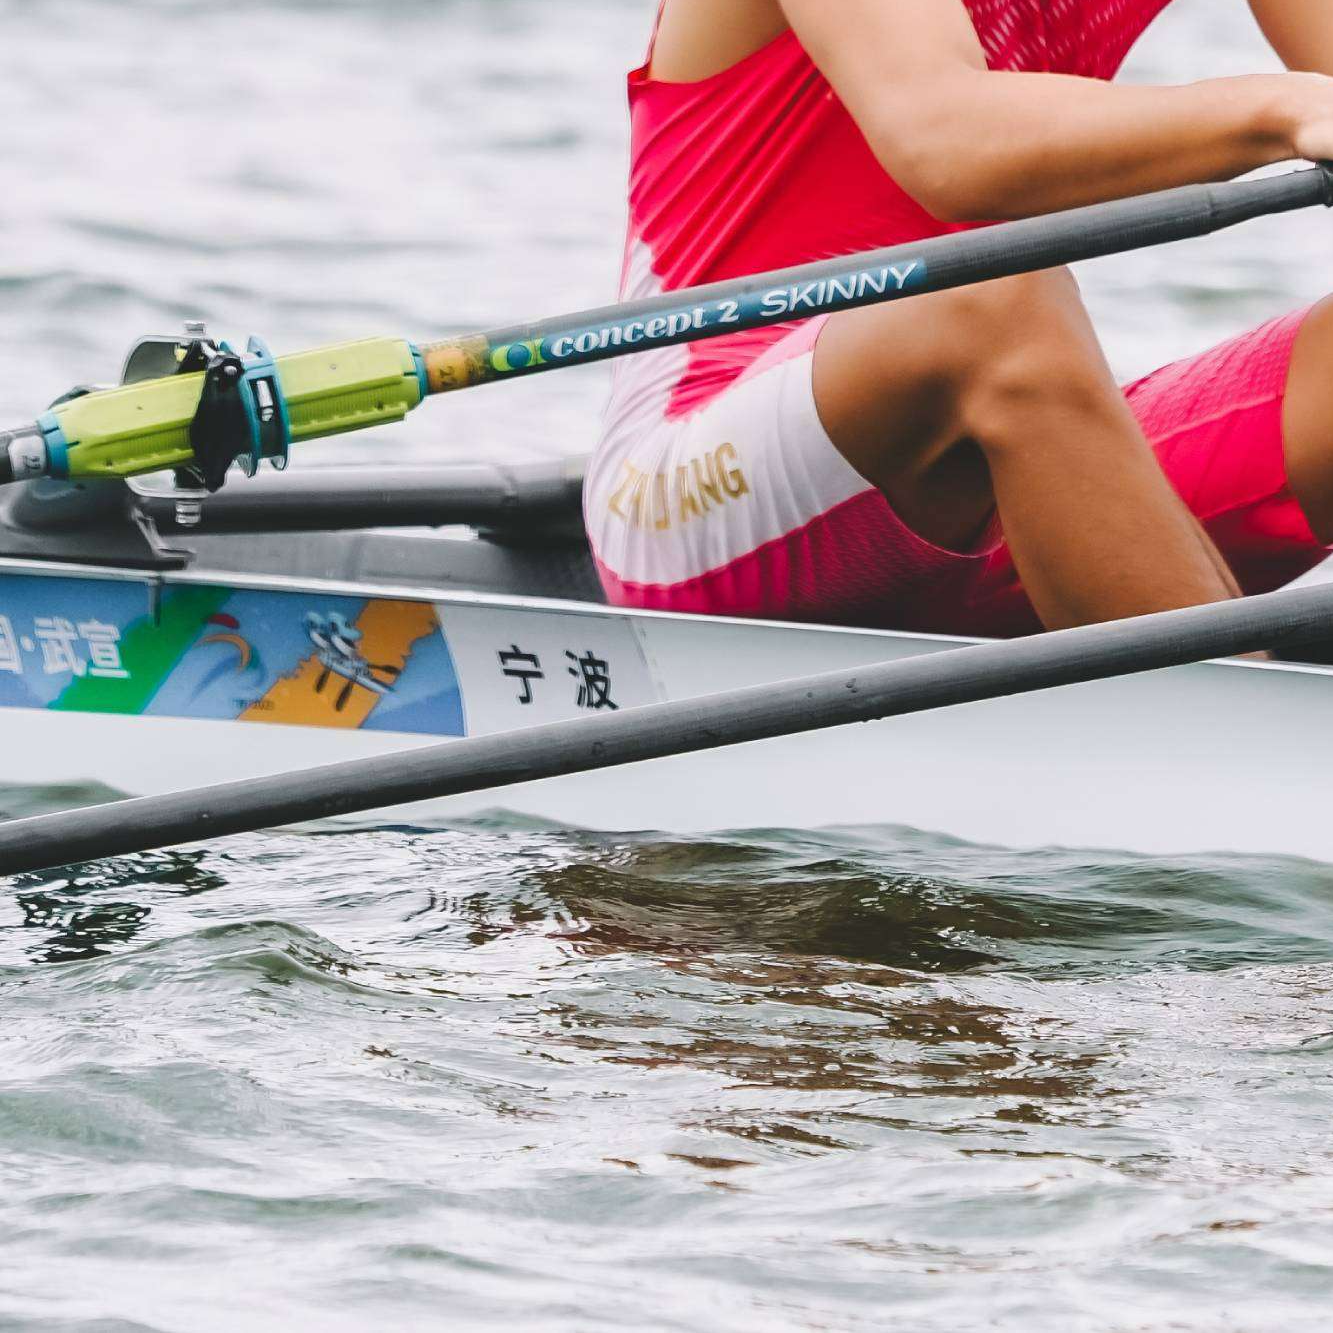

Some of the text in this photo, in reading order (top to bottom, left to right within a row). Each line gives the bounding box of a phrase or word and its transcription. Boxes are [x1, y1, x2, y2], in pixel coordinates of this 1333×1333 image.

[551, 263, 918, 357] concept 2 SKINNY
[498, 644, 619, 710] 宁波
